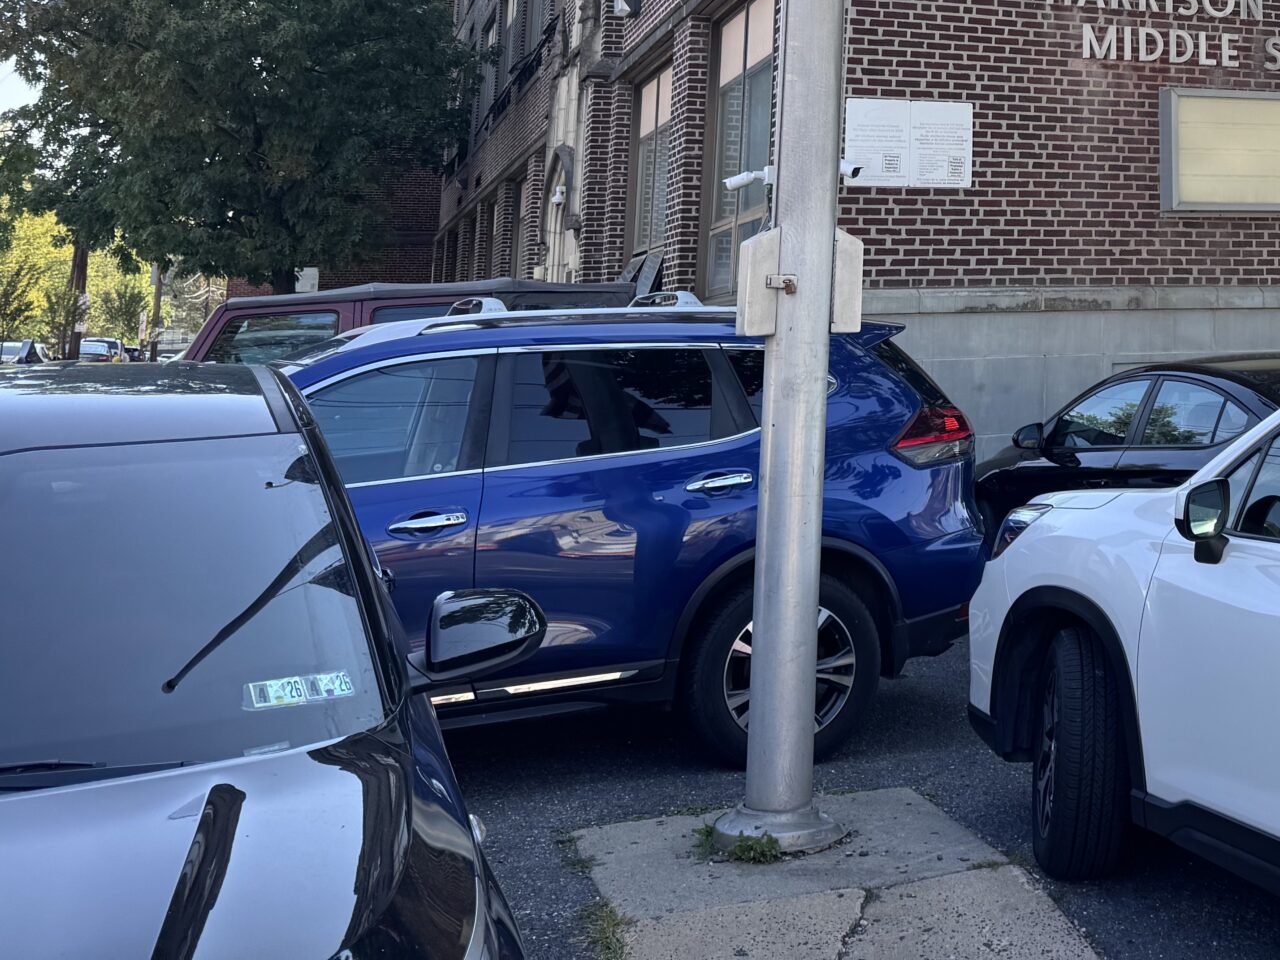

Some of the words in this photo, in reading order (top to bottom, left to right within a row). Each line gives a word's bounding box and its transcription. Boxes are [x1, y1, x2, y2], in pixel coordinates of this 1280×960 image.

[1082, 23, 1239, 67] MIDDLE
[257, 687, 267, 703] 4
[287, 680, 302, 698] 26
[310, 679, 319, 696] 4
[335, 674, 351, 692] 26
